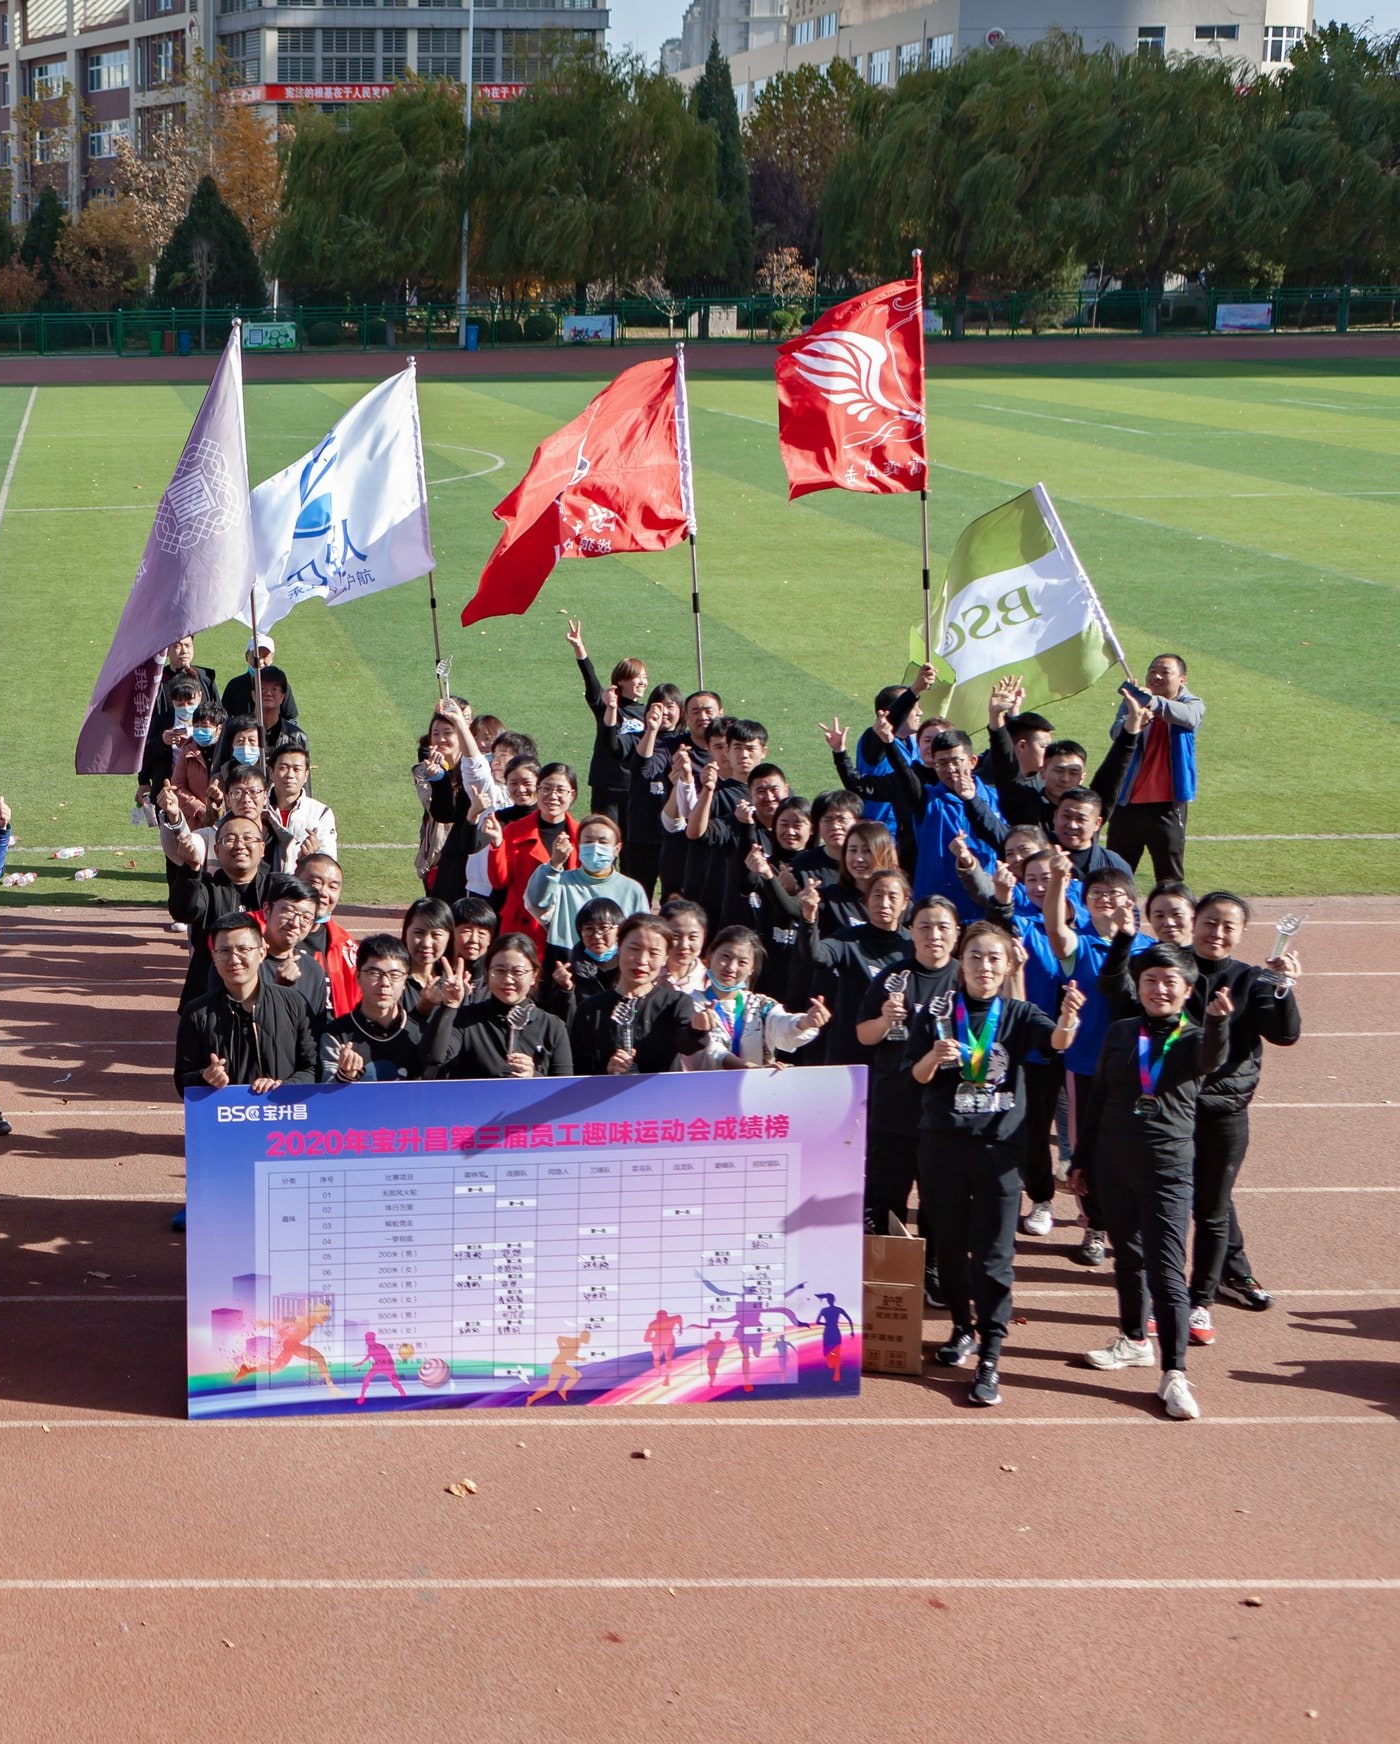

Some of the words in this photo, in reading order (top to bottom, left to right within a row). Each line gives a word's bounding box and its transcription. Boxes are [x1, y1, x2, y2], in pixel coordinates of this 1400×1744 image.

[263, 1103, 307, 1121] 宝升昌
[266, 1114, 789, 1157] 2020年宝升昌第三届员工趣味运动会成绩榜
[385, 1174, 414, 1182] 比赛项目
